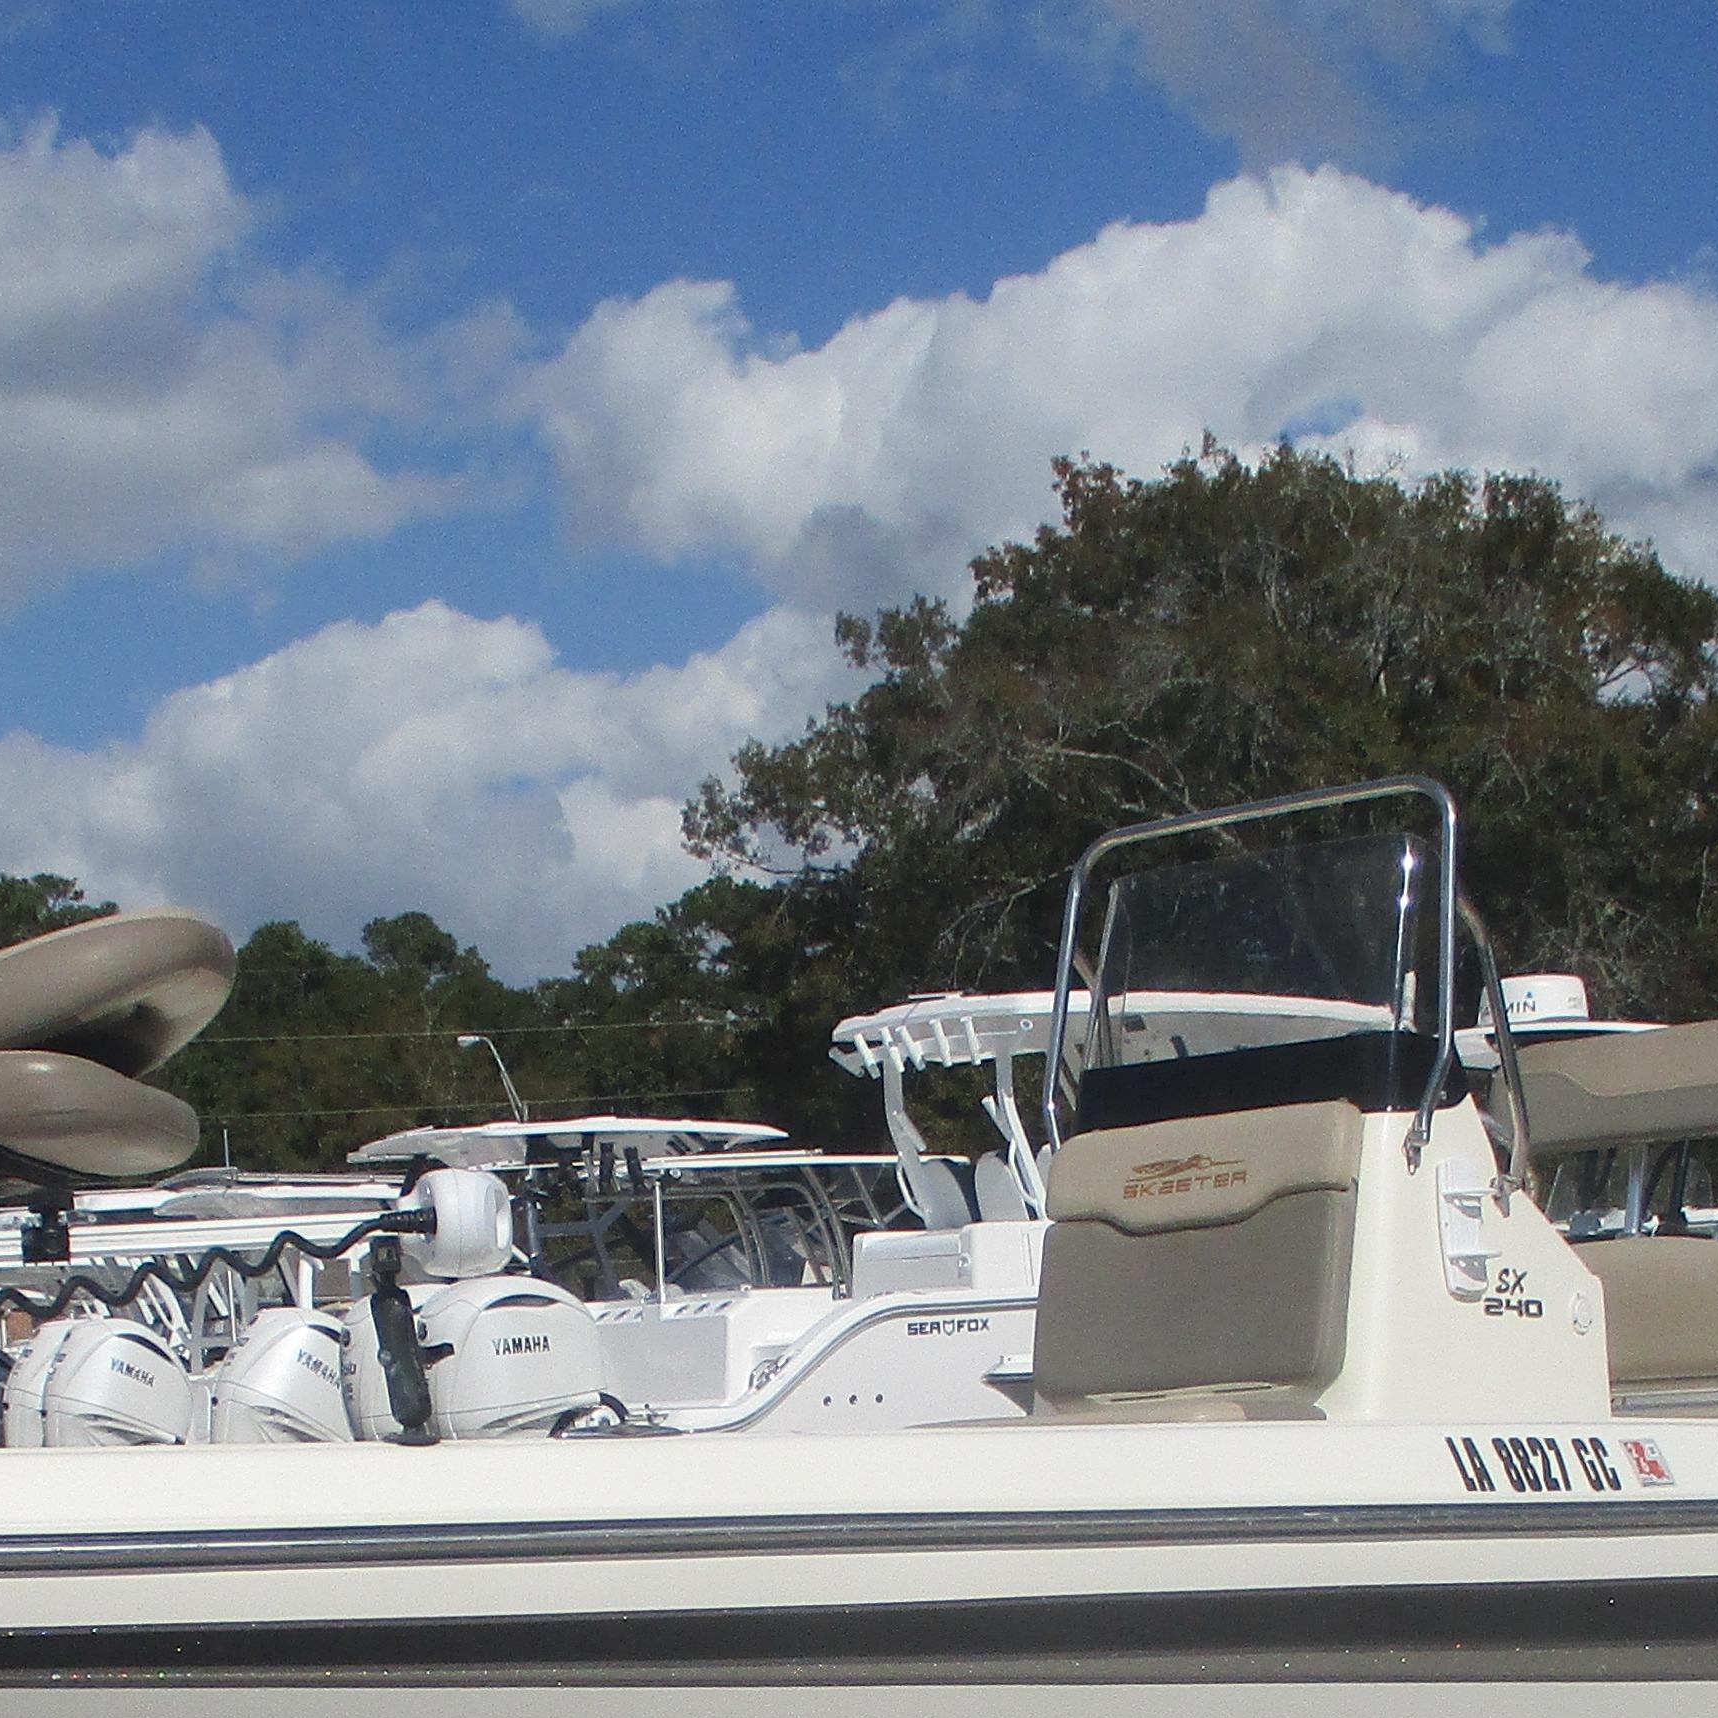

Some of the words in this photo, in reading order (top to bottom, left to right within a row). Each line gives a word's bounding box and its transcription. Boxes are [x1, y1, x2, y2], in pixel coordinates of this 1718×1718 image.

[1123, 1170, 1247, 1199] SKEETER
[1495, 1268, 1528, 1296] SX
[1484, 1298, 1543, 1318] 240
[907, 1321, 941, 1336] SEA
[956, 1318, 991, 1333] FOX
[491, 1335, 550, 1356] YAMAHA
[110, 1357, 155, 1388] YAMAHA
[1445, 1437, 1496, 1491] LA
[1491, 1437, 1572, 1492] 8827
[1571, 1437, 1622, 1491] GC
